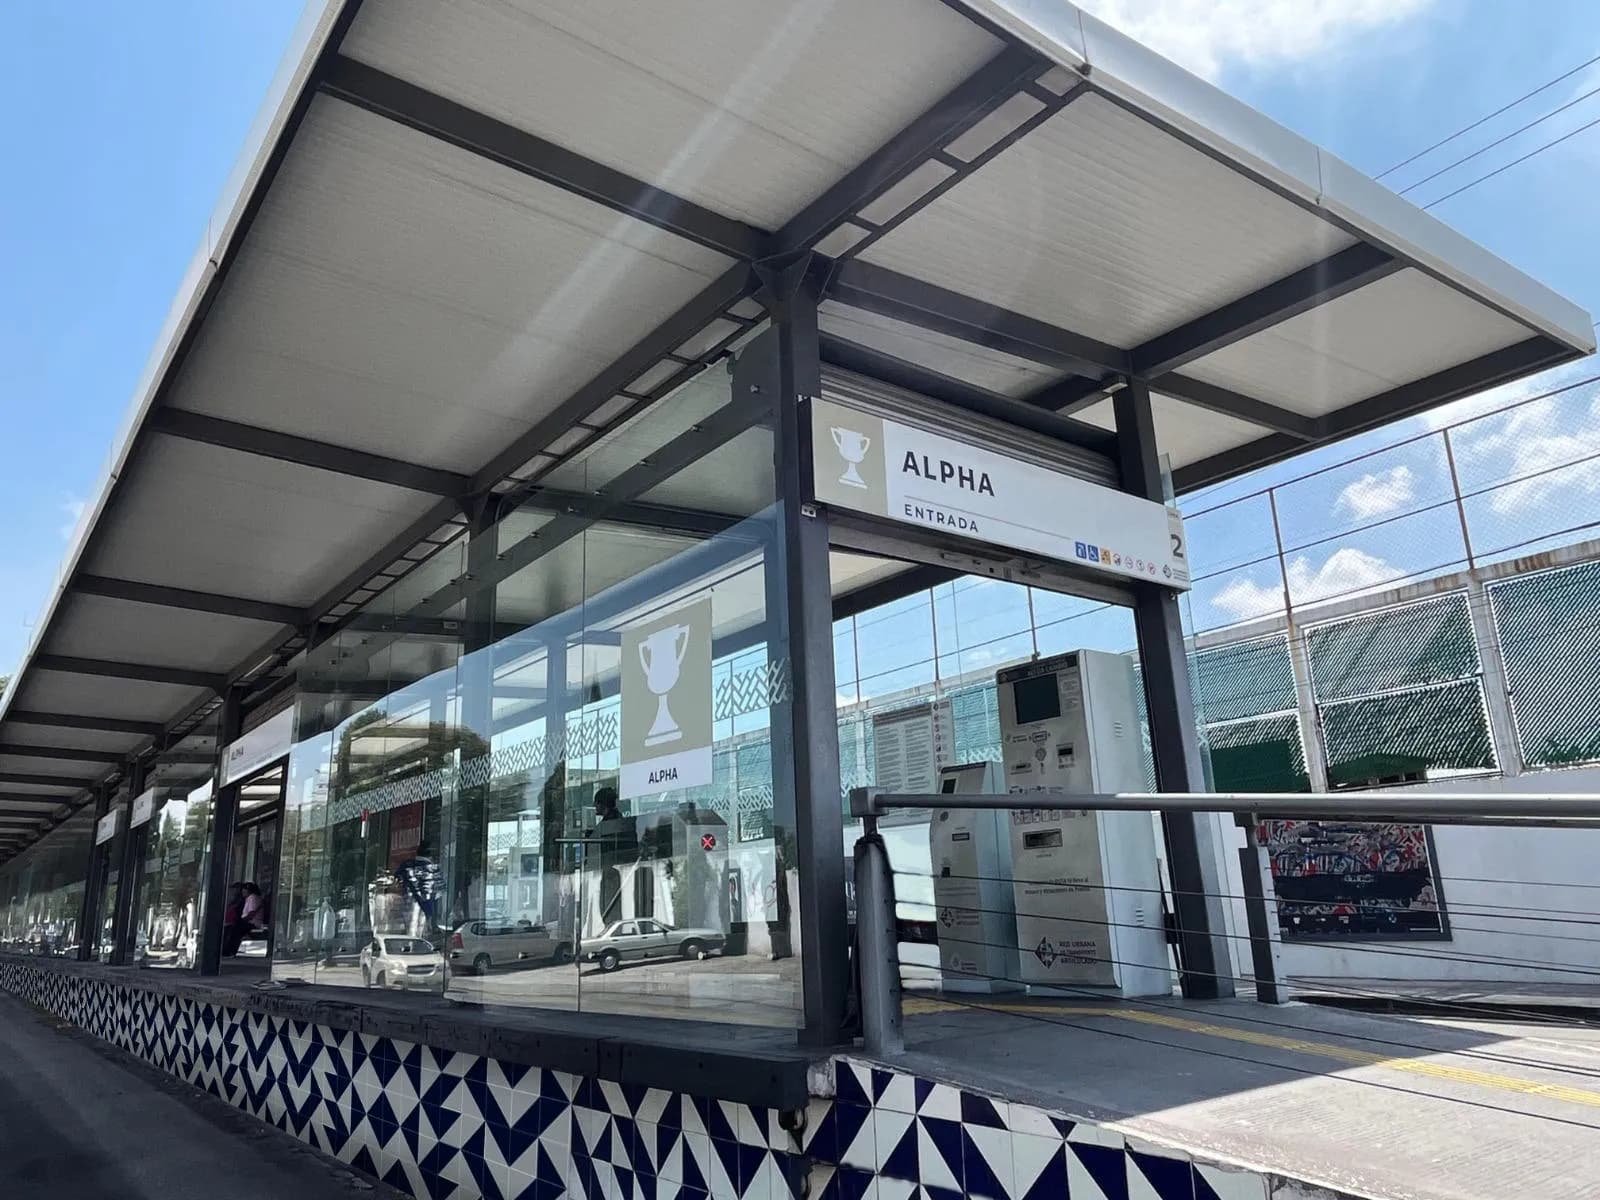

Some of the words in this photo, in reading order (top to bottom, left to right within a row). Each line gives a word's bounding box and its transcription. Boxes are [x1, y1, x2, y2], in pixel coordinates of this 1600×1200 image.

[902, 450, 995, 497] ALPHA
[904, 503, 979, 533] ENTRADA
[1170, 533, 1184, 559] 2
[648, 767, 678, 785] ALPHA
